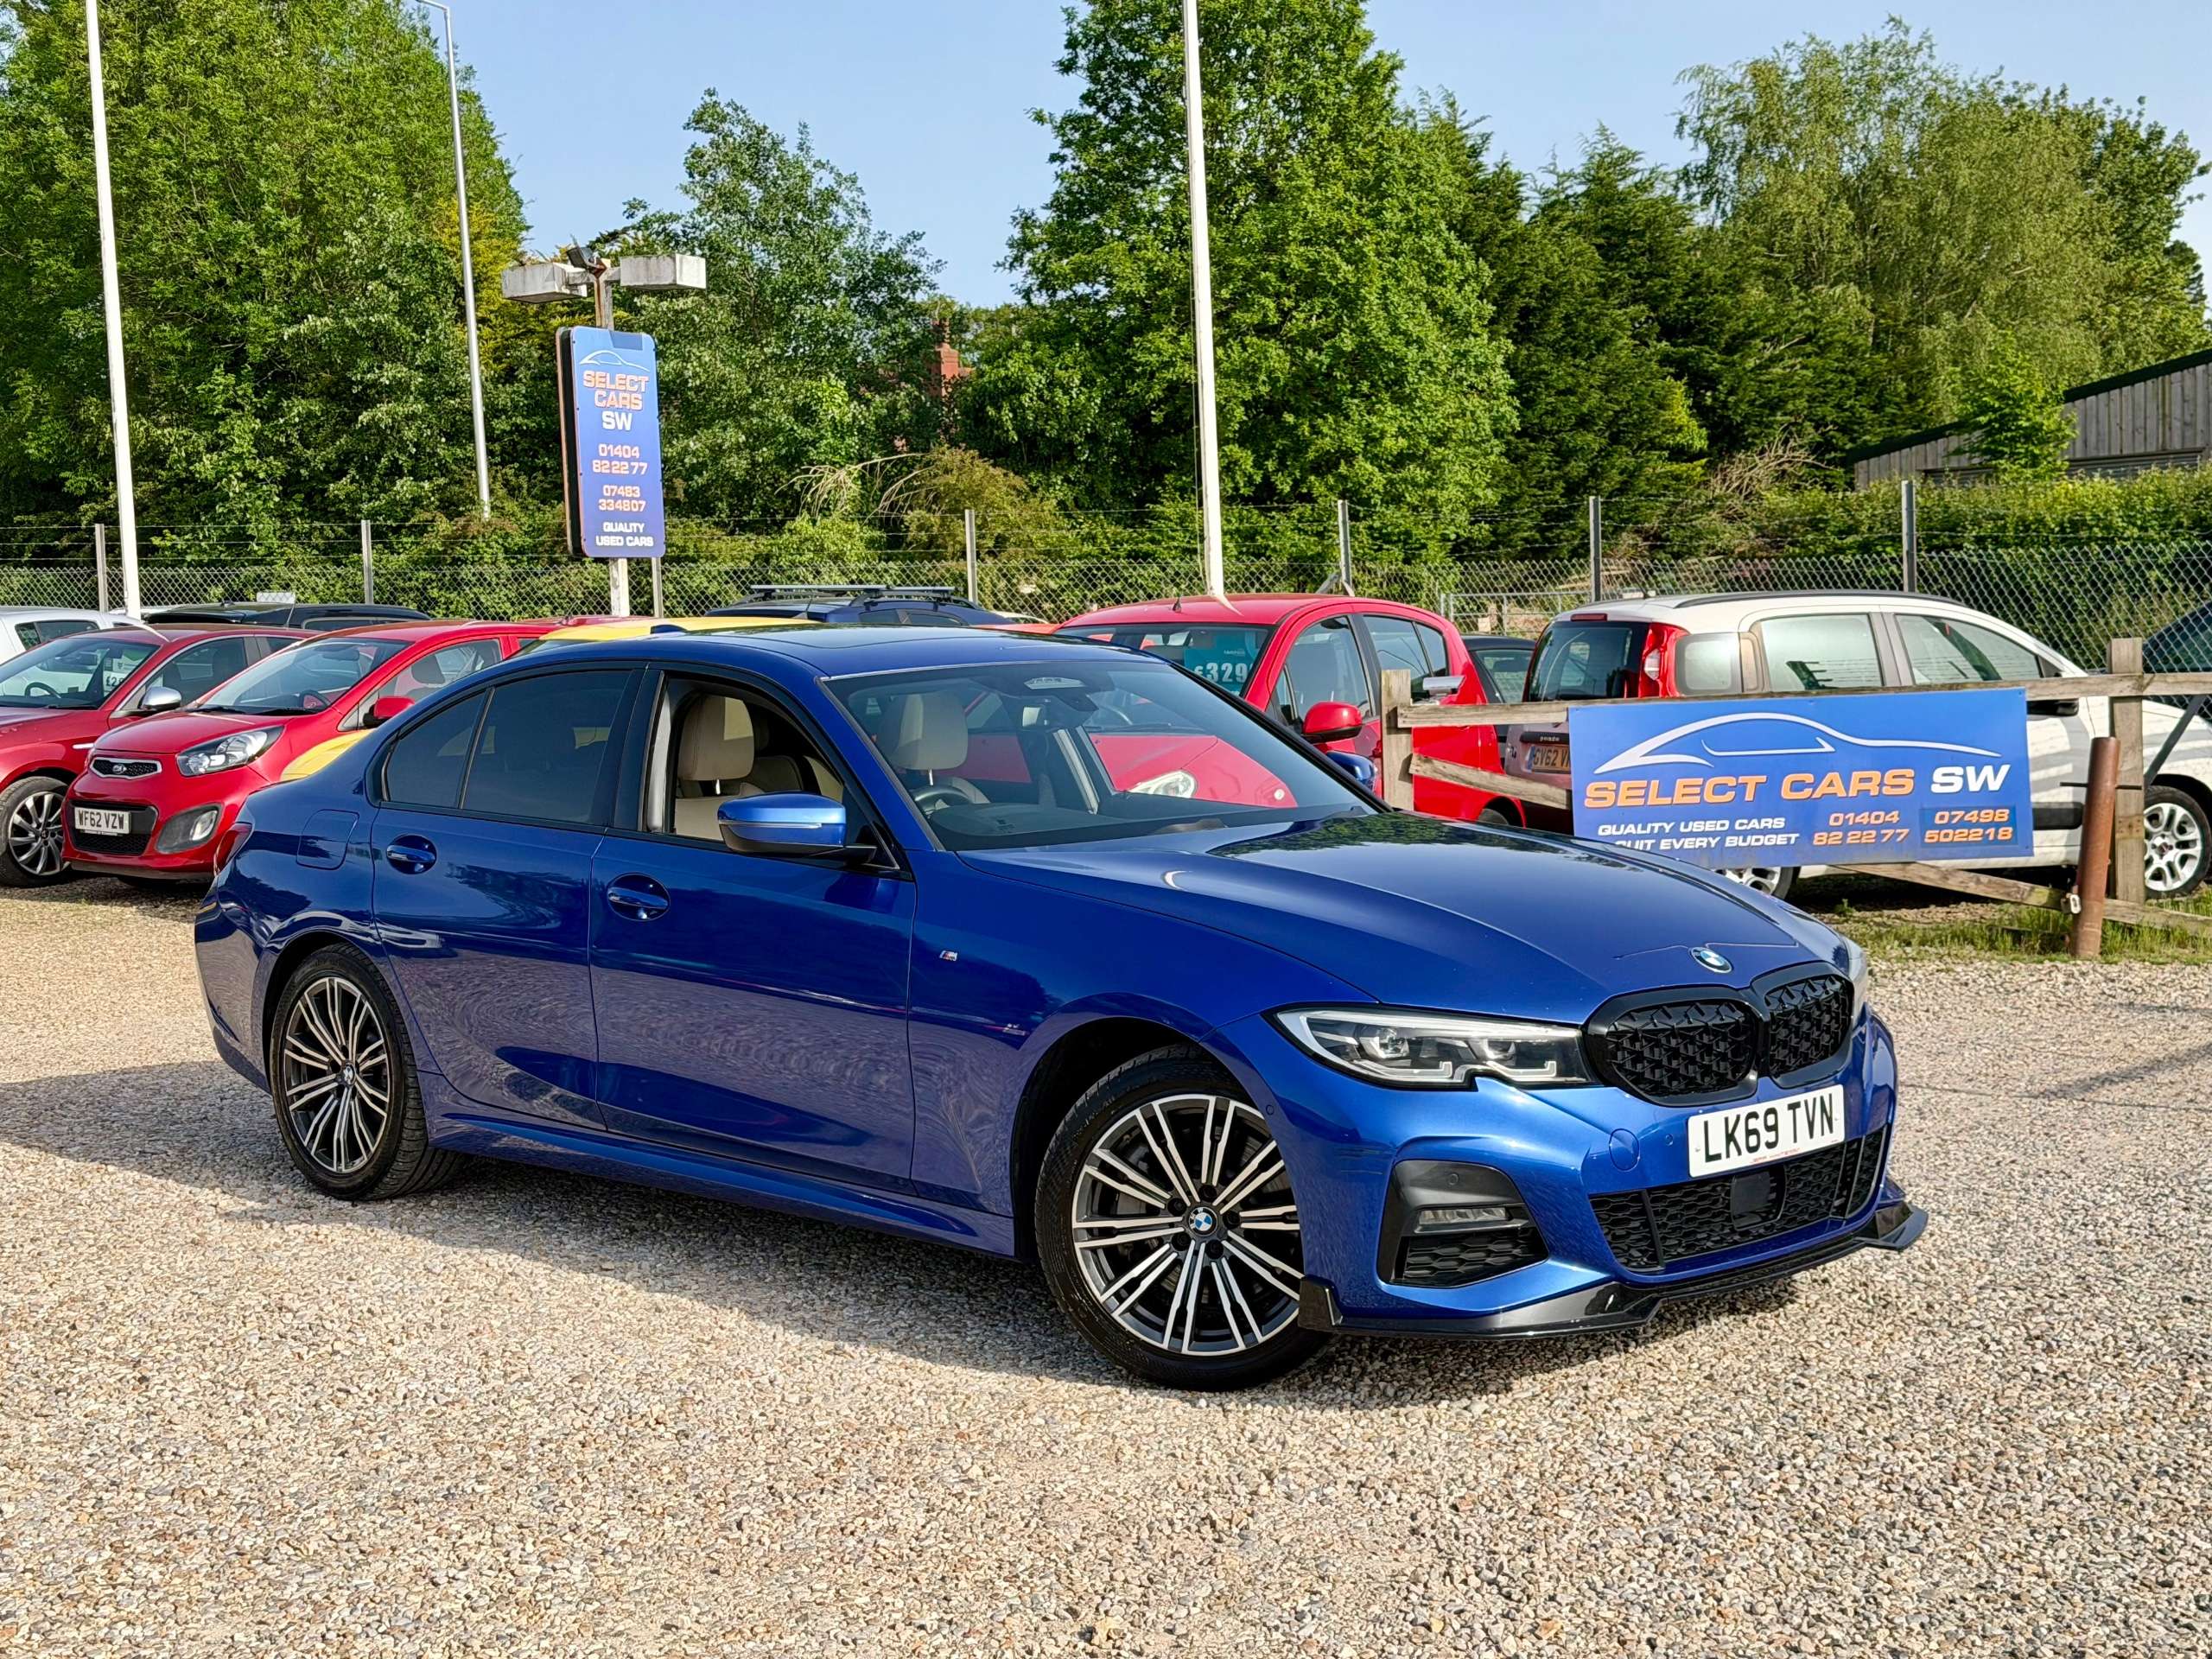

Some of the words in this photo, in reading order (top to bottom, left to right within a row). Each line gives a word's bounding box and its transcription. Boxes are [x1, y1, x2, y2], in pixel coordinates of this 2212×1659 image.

[583, 370, 649, 392] SELECT
[594, 390, 642, 410] CARS
[602, 410, 632, 431] SW
[598, 443, 640, 459] 01404
[598, 499, 646, 512] 334807
[602, 522, 645, 533] QUALITY
[595, 535, 624, 546] USED
[626, 536, 654, 547] CARS
[1194, 662, 1253, 683] £329
[1584, 775, 1768, 809] SELECT
[1781, 768, 1916, 800] CARS
[1930, 764, 2012, 794] SW
[78, 810, 102, 828] WF62
[104, 812, 124, 830] VZW
[1828, 810, 1900, 827] 01404
[1934, 809, 2010, 825] 07498
[1598, 823, 1675, 836] QUALITY
[1679, 820, 1730, 832] USED
[1734, 817, 1786, 830] CARS
[1923, 826, 2014, 843] 502218
[1659, 836, 1721, 850] EVERY
[1725, 833, 1800, 848] BUDGET
[1703, 1107, 1779, 1163] LK69
[1787, 1093, 1834, 1143] TVN
